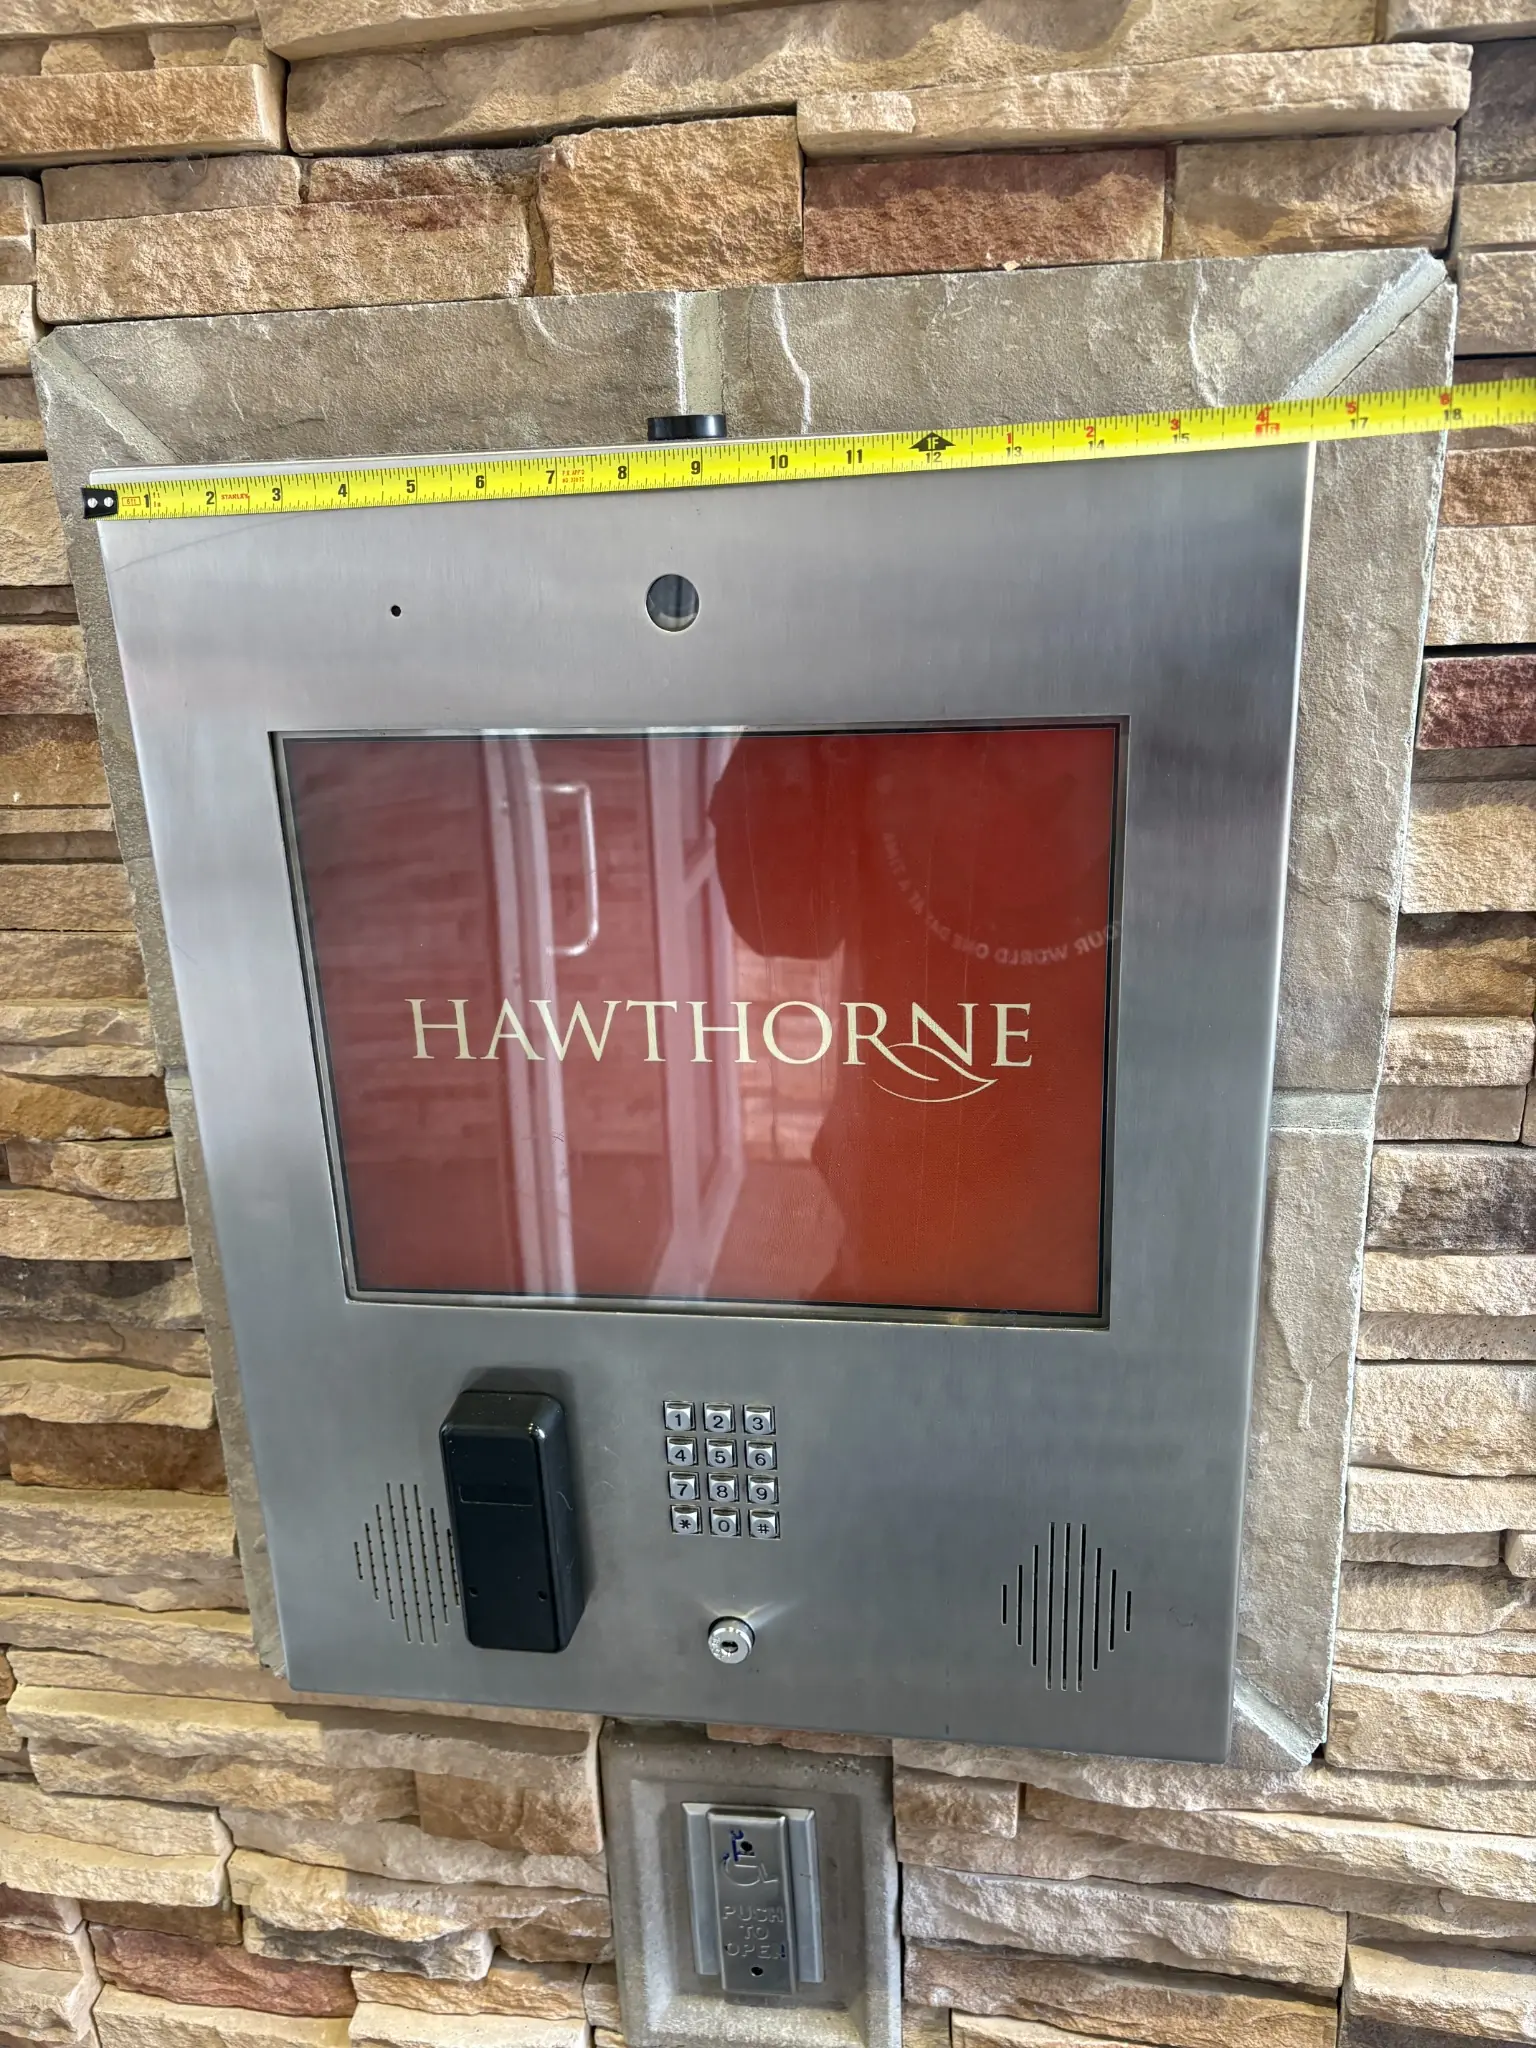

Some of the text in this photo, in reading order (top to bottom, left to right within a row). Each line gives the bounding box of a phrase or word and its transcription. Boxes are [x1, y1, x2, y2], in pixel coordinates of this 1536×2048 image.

[1007, 433, 1012, 444] 1
[1085, 426, 1094, 438] 2
[1170, 419, 1180, 431] 3
[1346, 401, 1356, 415] 5
[143, 408, 1462, 508] 1 2 3 4 5 6 7 8 9 10 11 12 13 14 15 17 18
[220, 493, 249, 501] STANLEY
[404, 997, 1033, 1084] HAWTHORNE
[674, 1413, 764, 1431] 1 2 3
[675, 1449, 766, 1466] 4 5 6
[677, 1483, 767, 1500] 7 8 9
[718, 1519, 730, 1532] 0
[722, 1904, 784, 1923] PUSH
[739, 1924, 769, 1940] TO
